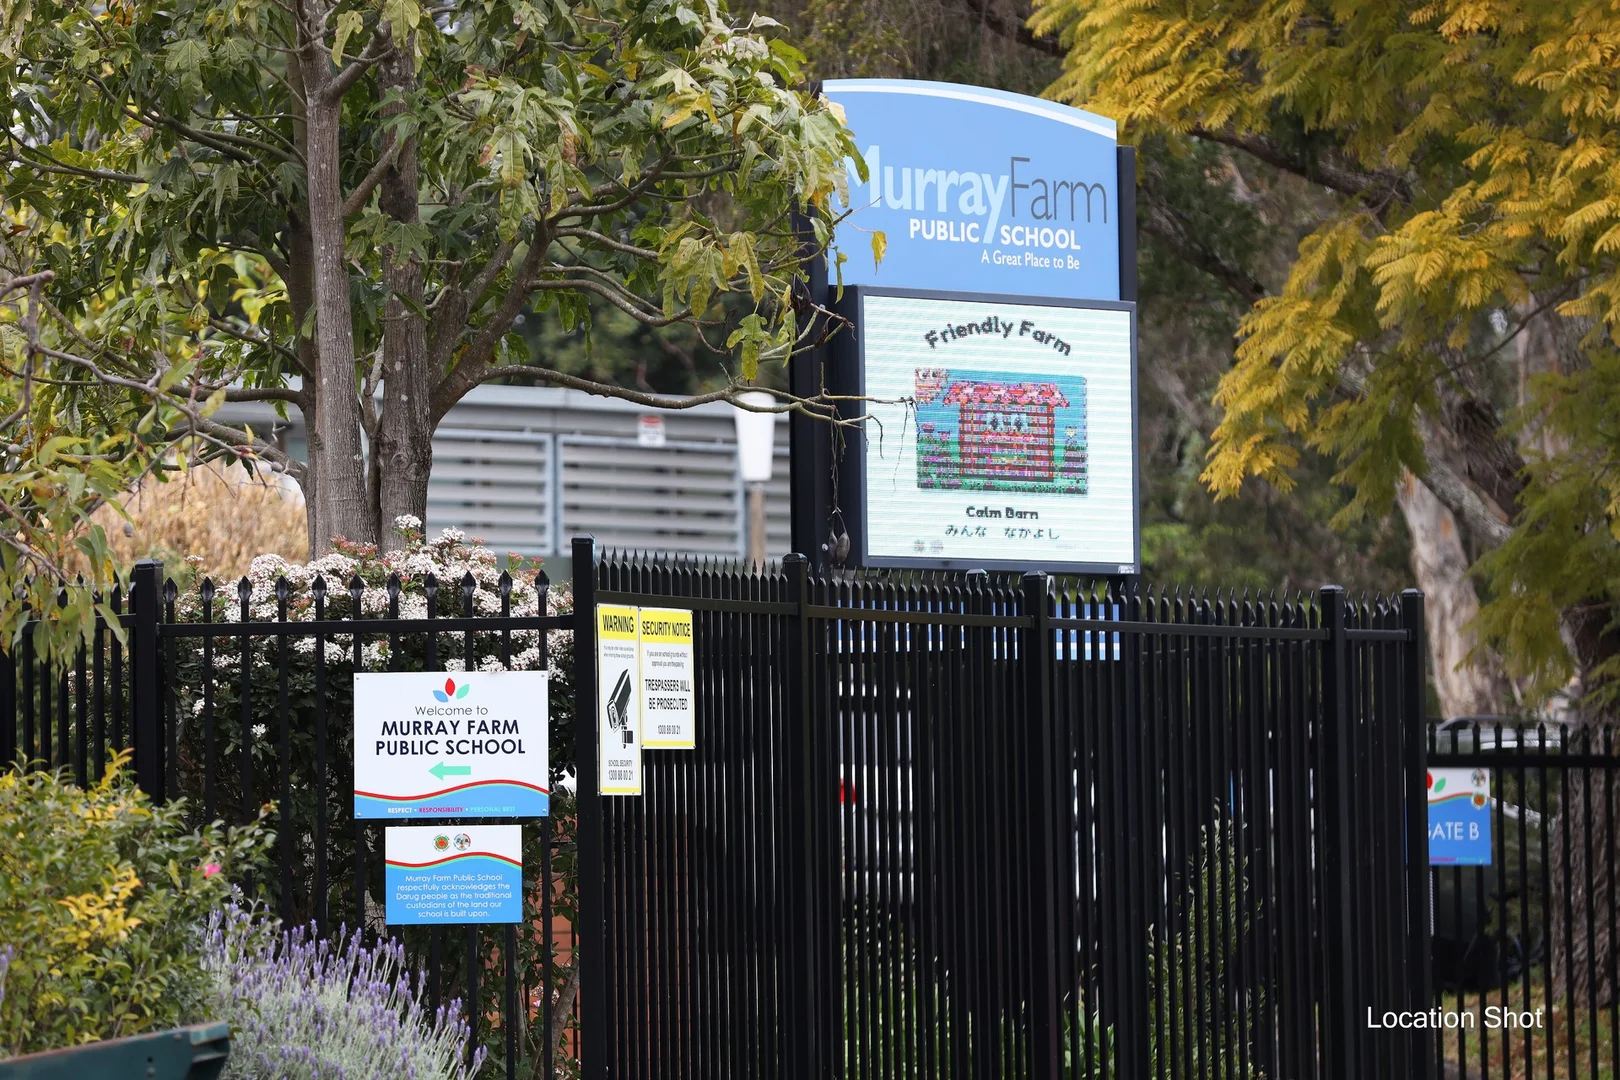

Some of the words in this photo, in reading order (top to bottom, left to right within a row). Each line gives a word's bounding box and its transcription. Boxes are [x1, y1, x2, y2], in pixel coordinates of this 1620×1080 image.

[909, 218, 980, 243] PUBLIC
[1000, 225, 1081, 250] SCHOOL
[981, 250, 990, 264] A
[992, 252, 1022, 267] Great
[1024, 252, 1050, 268] Place
[1052, 256, 1064, 269] to
[1066, 255, 1080, 270] Be
[924, 315, 1014, 349] Friendly
[1019, 319, 1072, 357] Farm
[966, 505, 1002, 519] Calm
[1005, 506, 1039, 520] Barn
[945, 524, 987, 538] みんな
[1003, 526, 1060, 540] なかよし
[602, 614, 635, 634] WARNING
[642, 620, 671, 637] SECURITY
[671, 622, 691, 637] NOTICE
[644, 679, 679, 692] TRESPASSERS
[679, 680, 691, 692] WILL
[415, 706, 473, 716] Welcome
[476, 705, 489, 716] to
[648, 697, 656, 710] BE
[656, 698, 688, 711] PROSECUTED
[381, 720, 460, 736] MURRAY
[467, 719, 520, 735] FARM
[376, 740, 439, 756] PUBLIC
[445, 739, 526, 755] SCHOOL
[1469, 821, 1480, 841] B
[405, 875, 431, 883] Murray
[432, 874, 452, 882] Farm
[477, 873, 503, 881] School
[397, 883, 440, 892] respectfully
[441, 882, 496, 891] acknowledges
[498, 882, 510, 890] the
[396, 893, 419, 902] Darug
[421, 892, 448, 901] people
[474, 891, 512, 899] traditional
[406, 901, 446, 909] custodians
[470, 900, 488, 908] land
